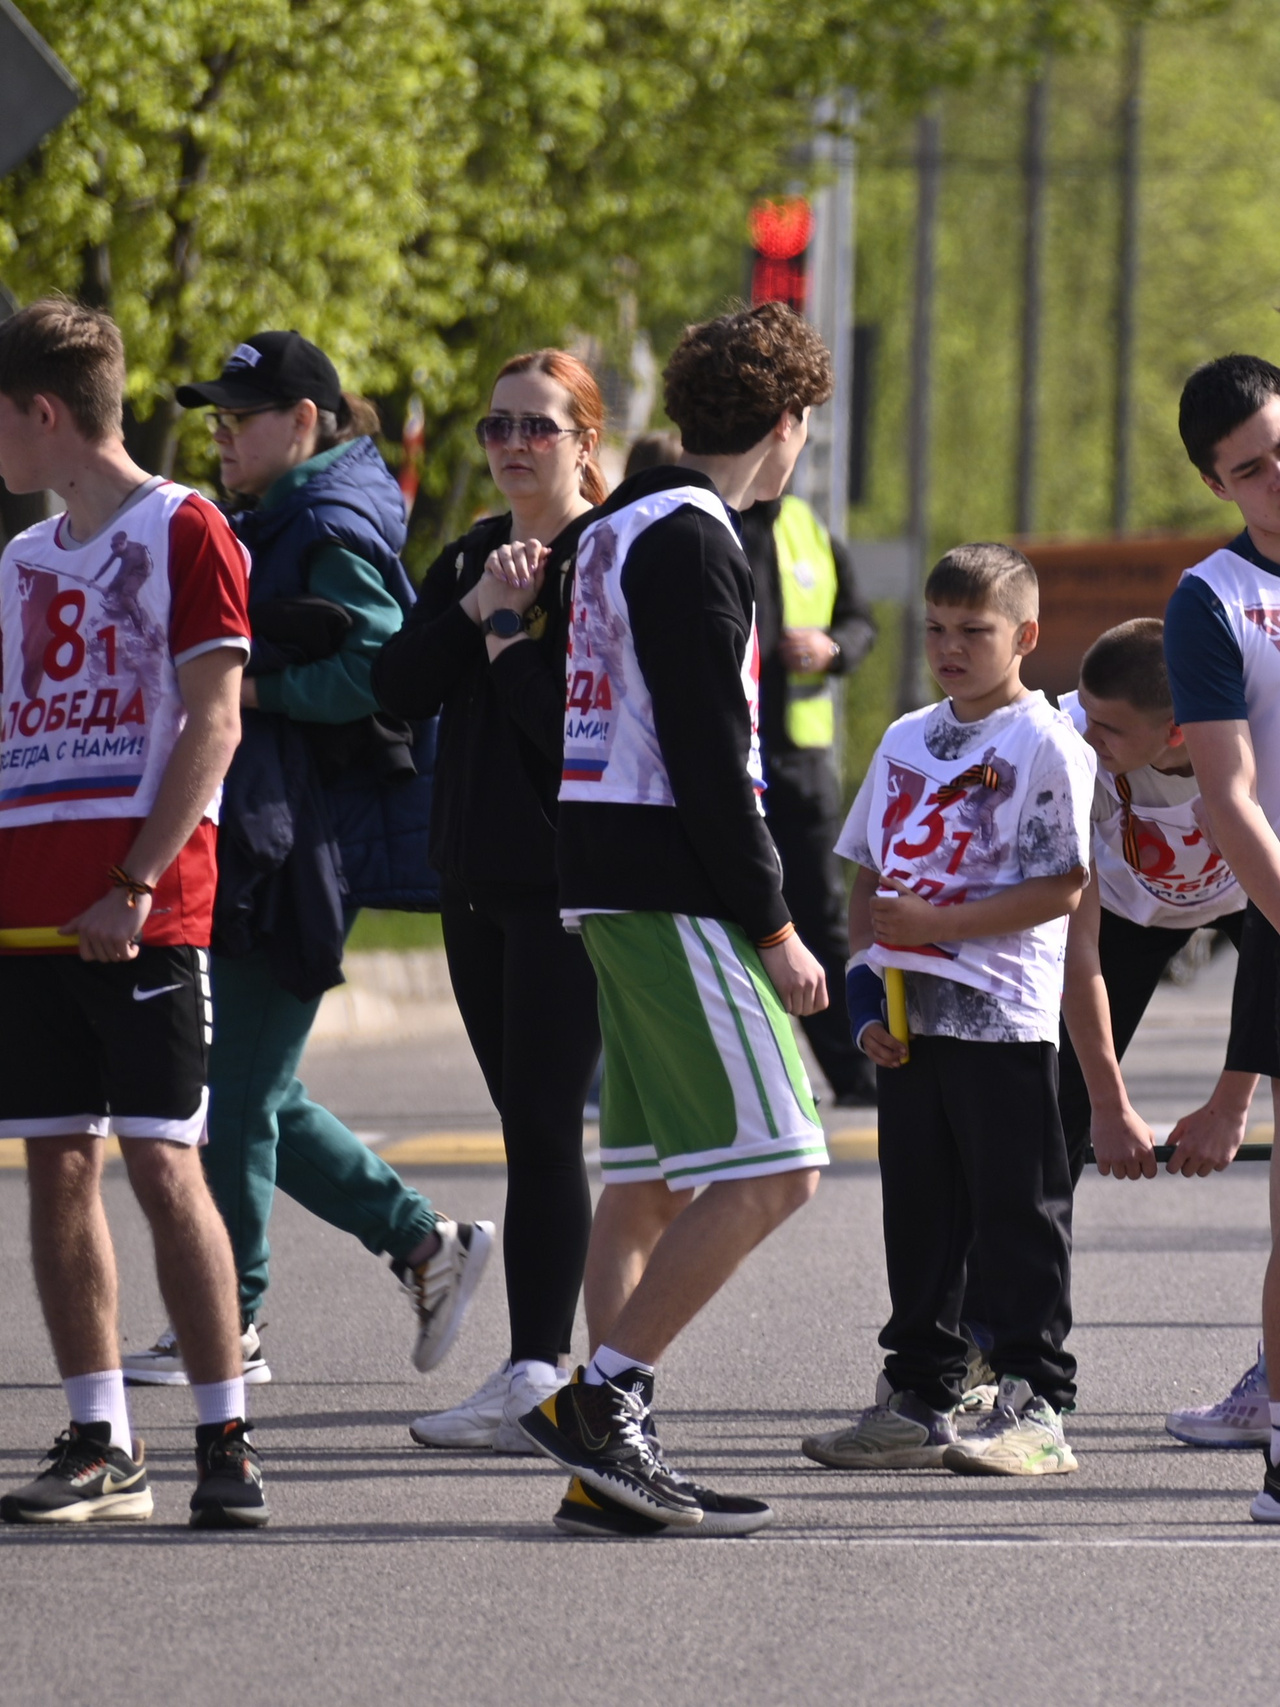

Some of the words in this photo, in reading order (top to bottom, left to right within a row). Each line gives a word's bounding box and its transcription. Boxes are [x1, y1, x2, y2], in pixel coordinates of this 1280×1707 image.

[42, 589, 87, 682] 8
[566, 670, 613, 716] ДА
[72, 735, 146, 758] НАМИ!
